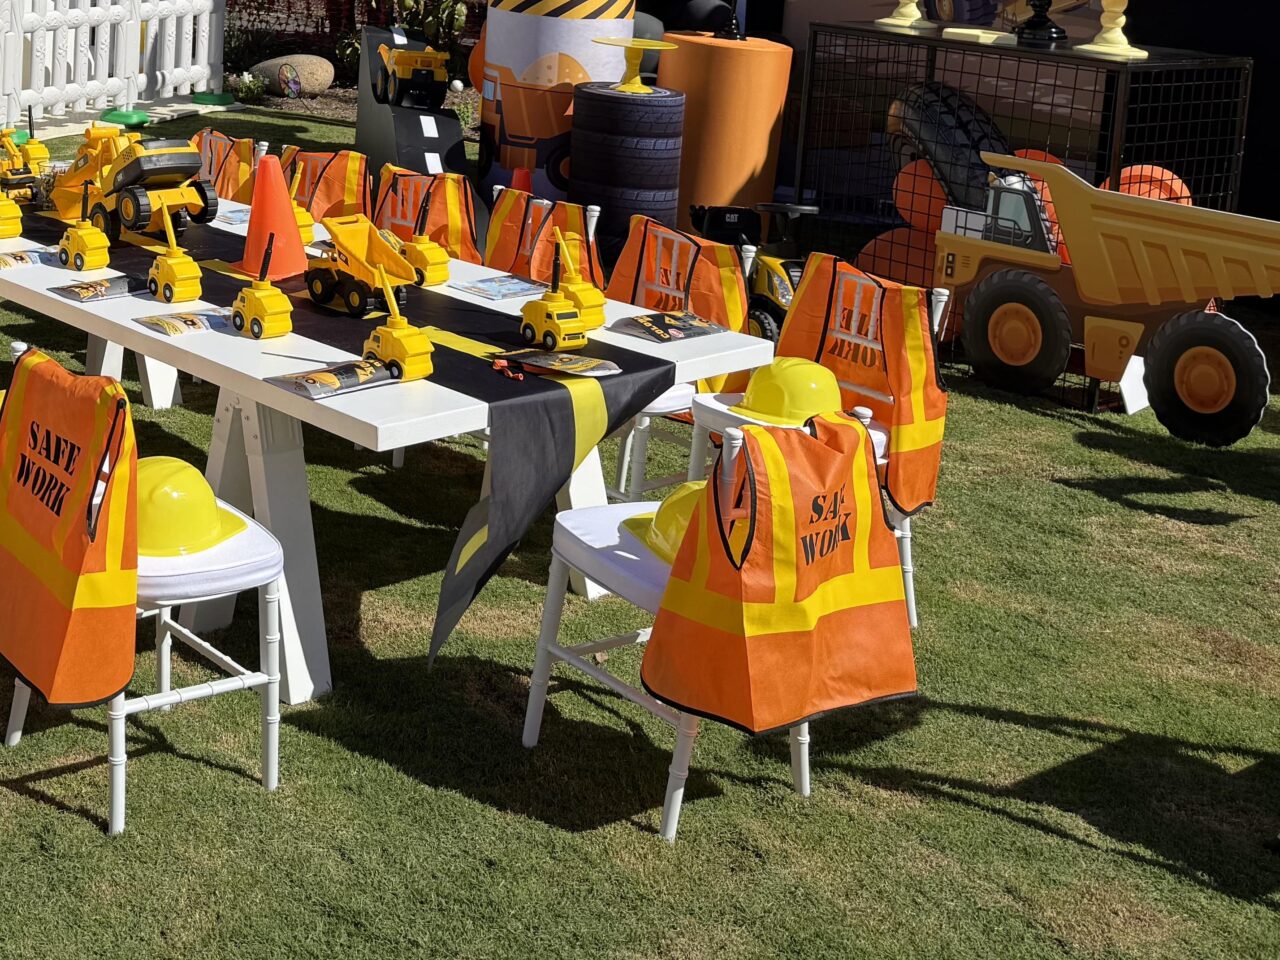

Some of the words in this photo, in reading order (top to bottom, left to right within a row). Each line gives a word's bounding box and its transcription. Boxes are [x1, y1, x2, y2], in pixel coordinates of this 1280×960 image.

[725, 213, 739, 223] CAT
[28, 420, 81, 477] SAFE
[16, 452, 71, 518] WORK
